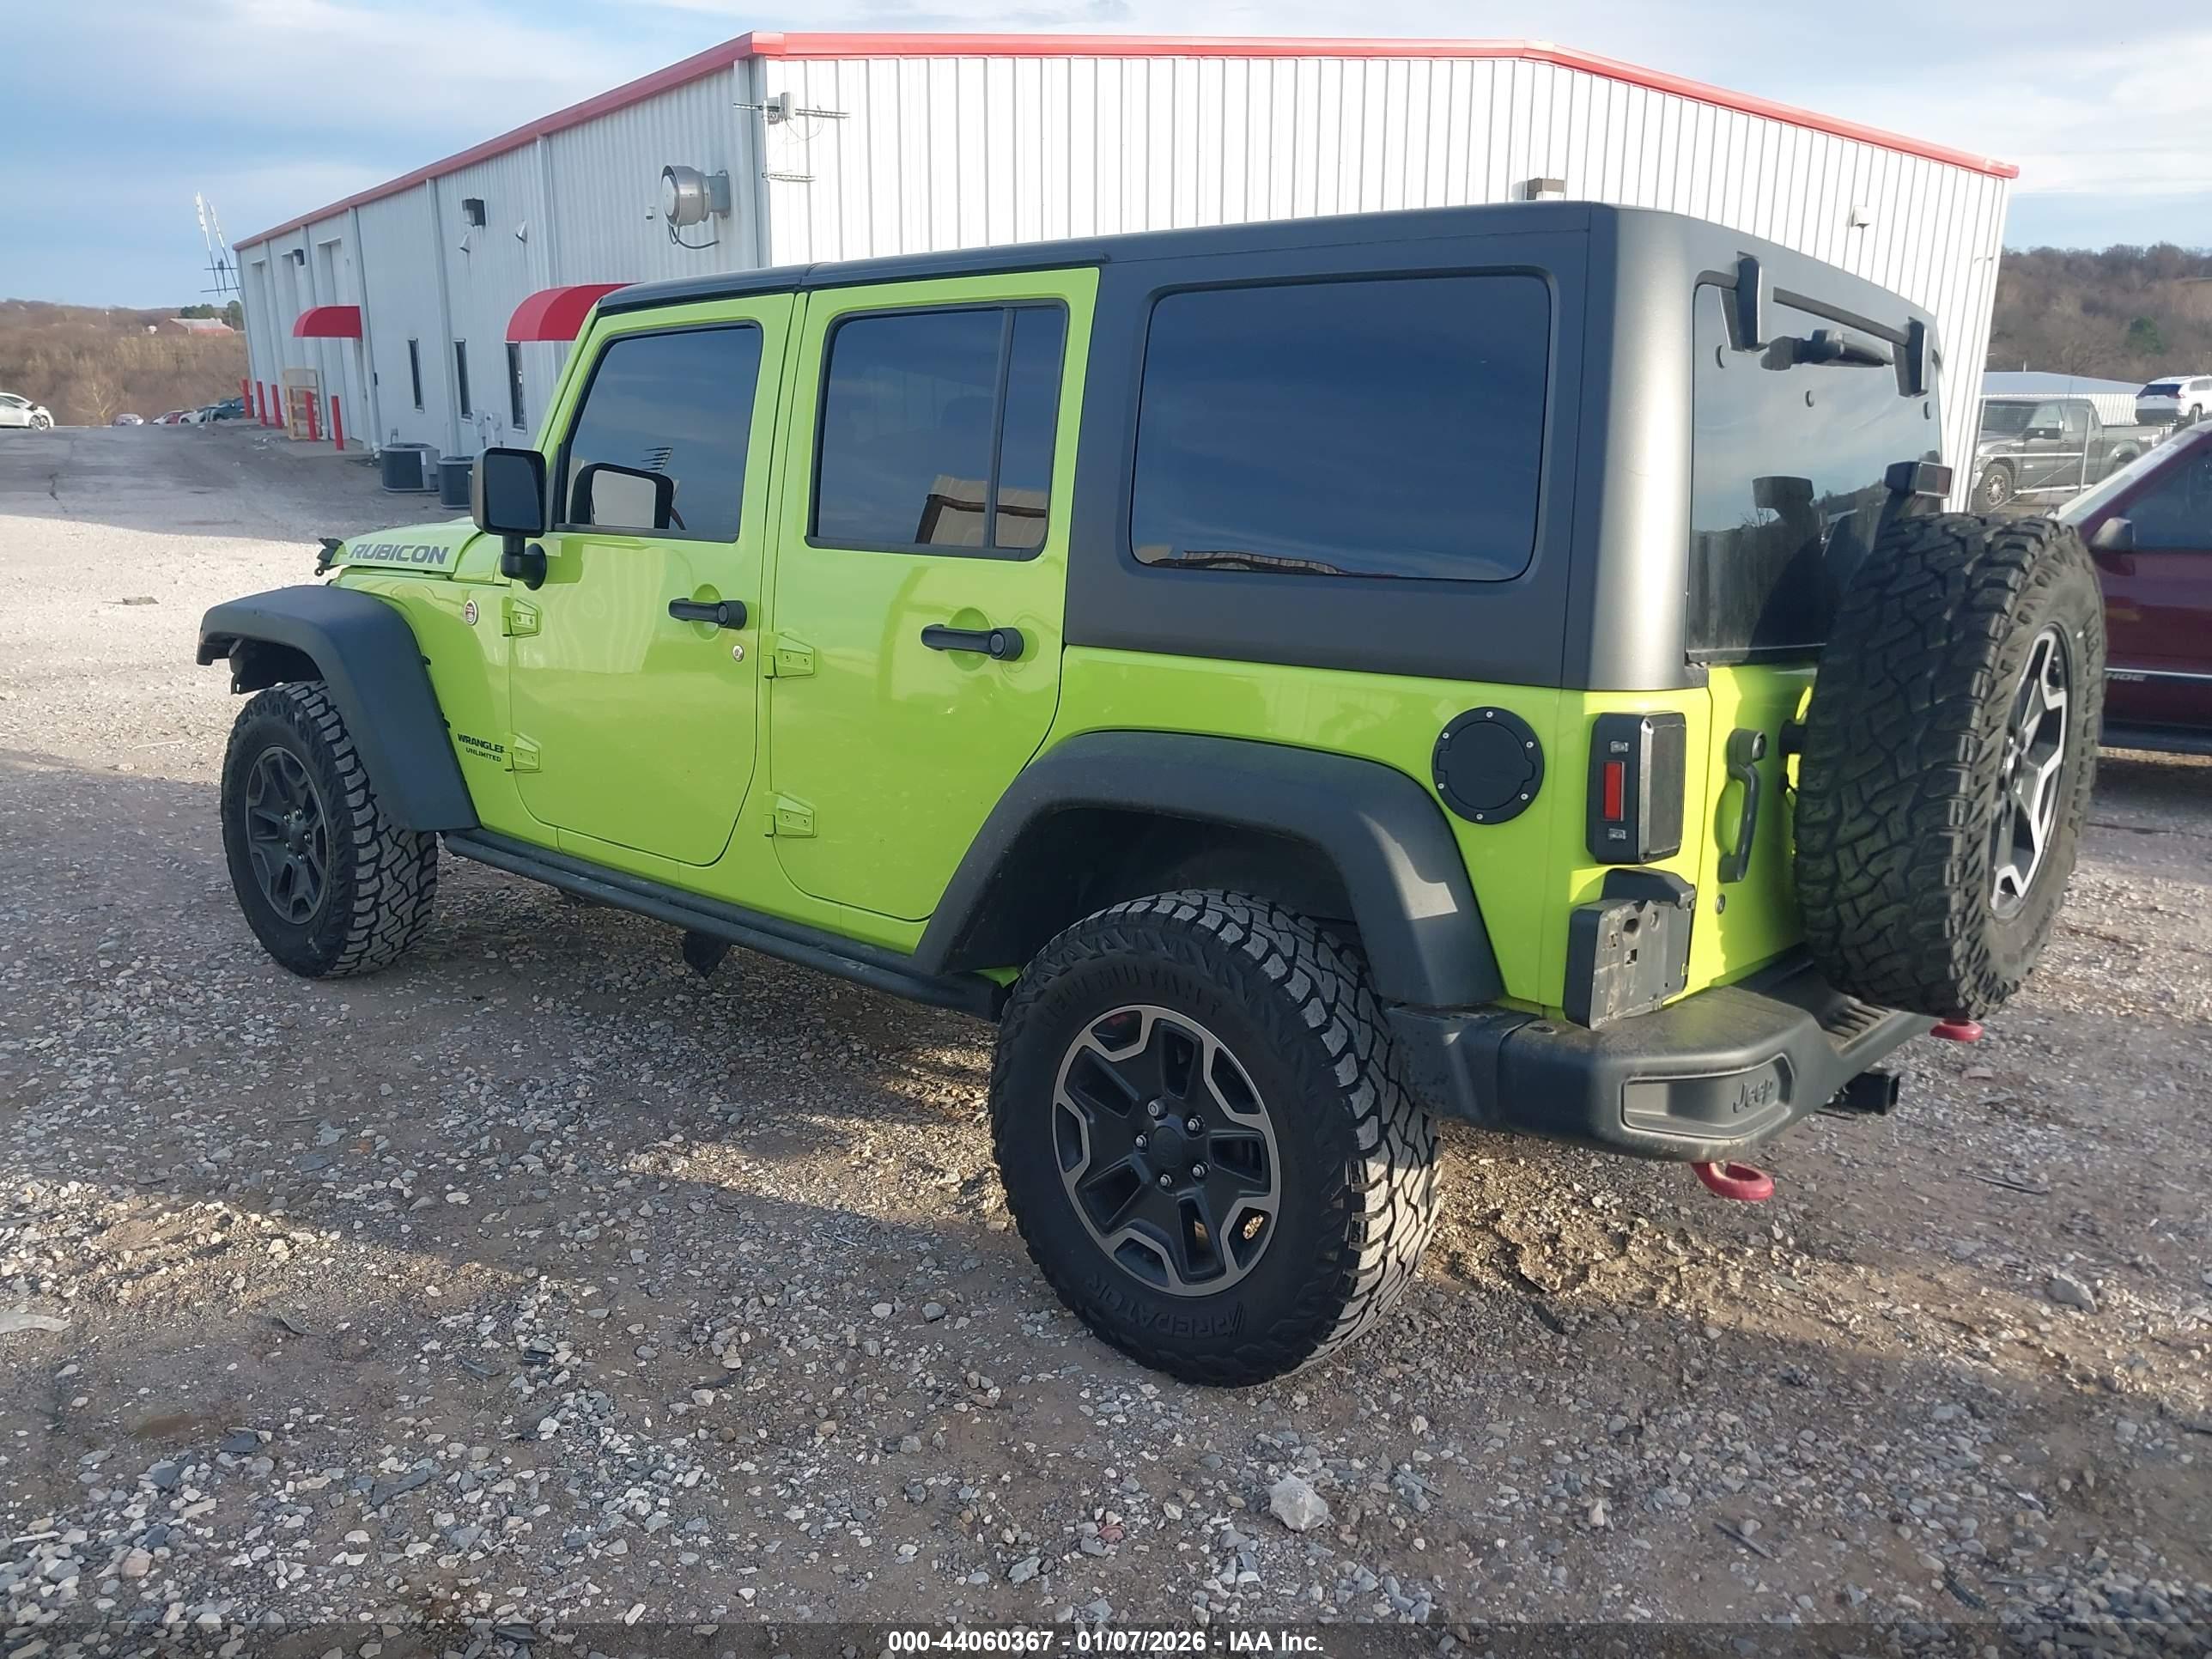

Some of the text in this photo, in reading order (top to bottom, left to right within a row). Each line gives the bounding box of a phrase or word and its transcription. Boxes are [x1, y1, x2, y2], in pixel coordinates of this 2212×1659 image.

[349, 544, 450, 565] RUBICON
[2104, 672, 2146, 681] HOE
[465, 746, 501, 763] UNLIMITED
[1731, 1078, 1773, 1114] Jeep
